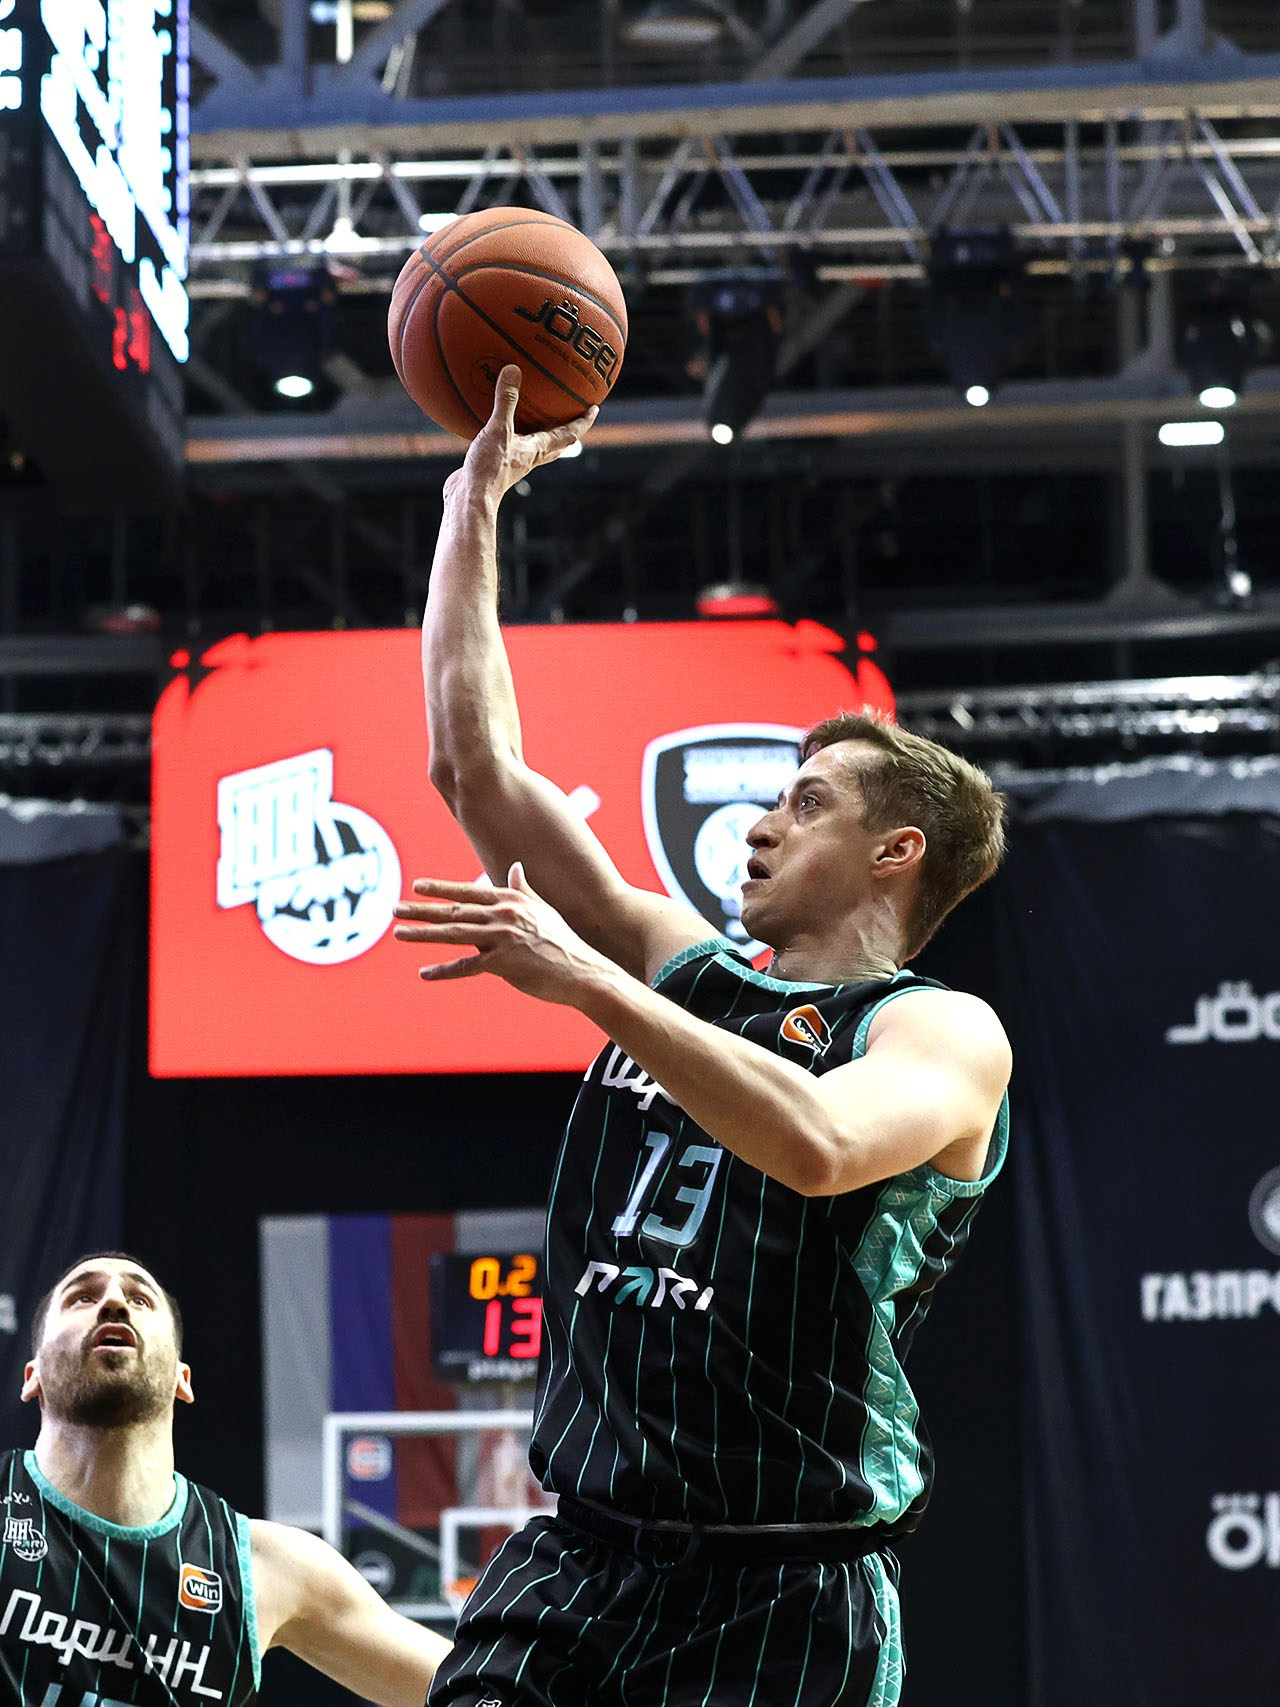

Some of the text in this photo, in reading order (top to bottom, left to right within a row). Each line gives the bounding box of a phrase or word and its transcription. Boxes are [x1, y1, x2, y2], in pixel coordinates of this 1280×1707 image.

[611, 1131, 724, 1247] 13
[469, 1253, 538, 1300] 0.2
[483, 1297, 543, 1358] 13
[188, 1580, 219, 1600] Win
[144, 1633, 223, 1700] НН
